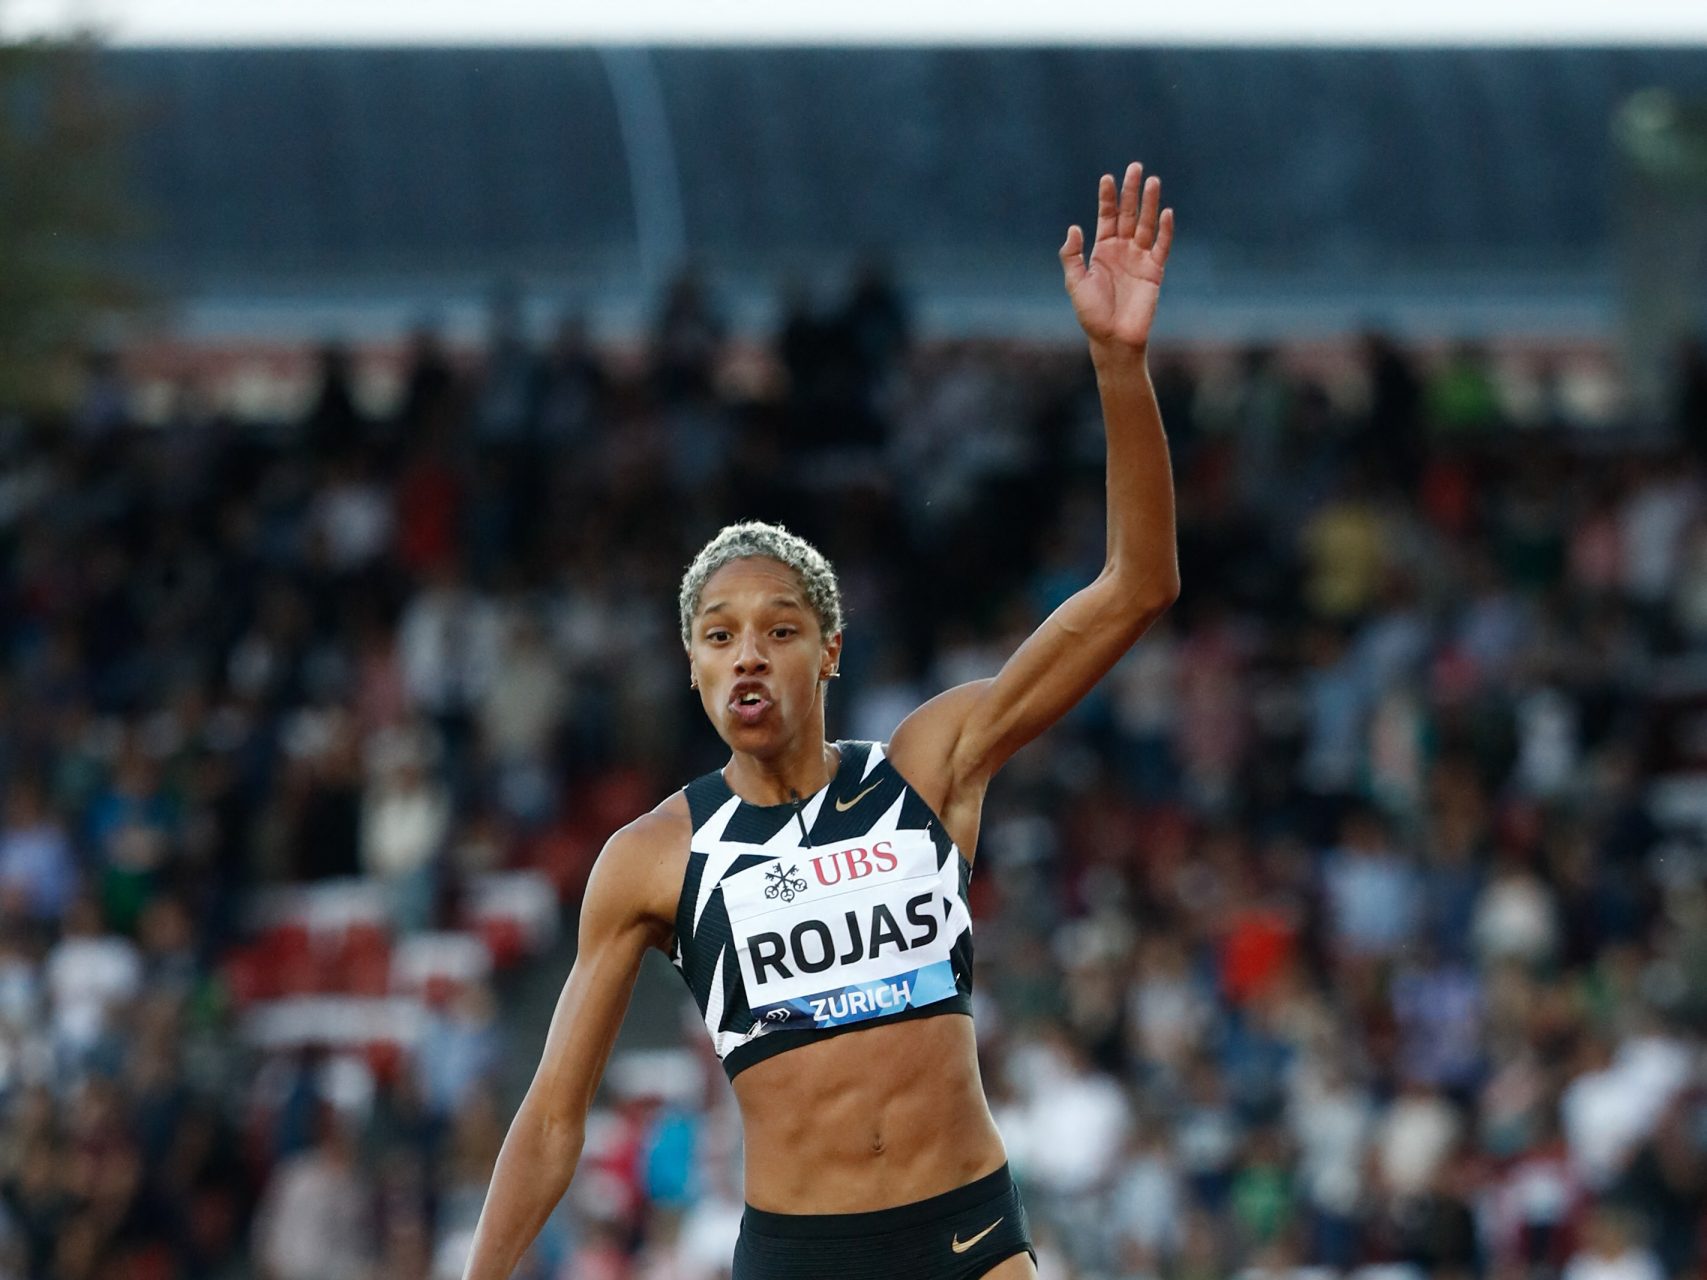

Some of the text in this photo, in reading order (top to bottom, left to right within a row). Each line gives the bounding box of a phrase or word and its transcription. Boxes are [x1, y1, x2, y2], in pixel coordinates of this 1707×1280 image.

[809, 841, 898, 887] UBS
[746, 892, 938, 985] ROJAS
[810, 980, 911, 1022] ZURICH
